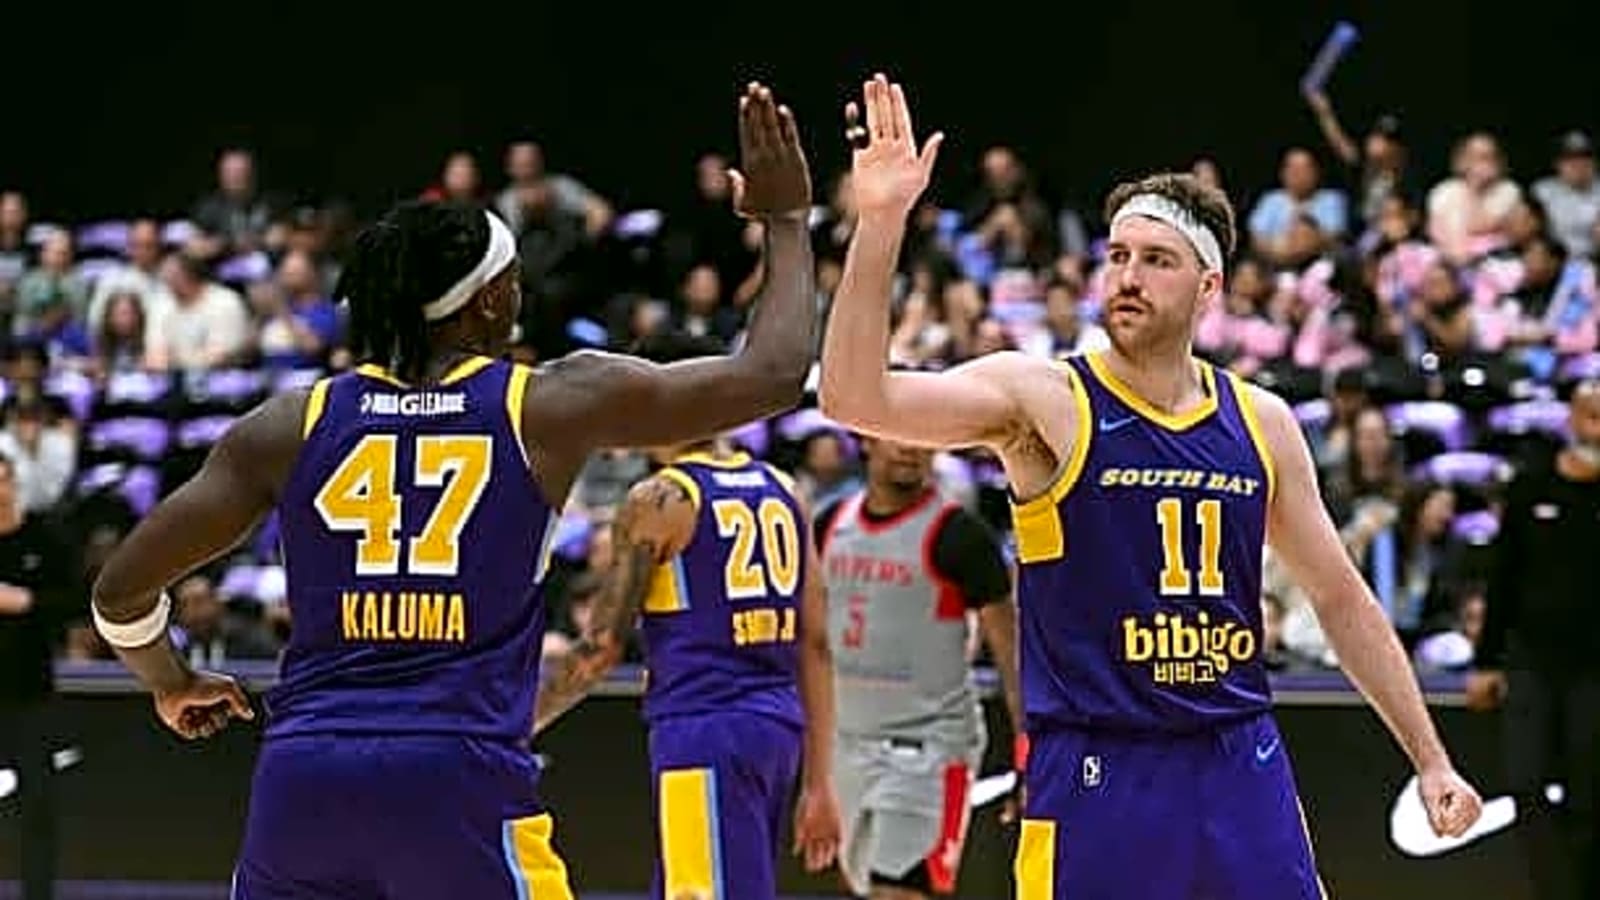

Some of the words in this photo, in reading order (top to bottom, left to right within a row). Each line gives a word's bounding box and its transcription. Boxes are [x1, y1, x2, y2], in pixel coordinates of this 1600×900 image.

[314, 435, 493, 575] 47
[1101, 468, 1204, 487] SOUTH
[1205, 472, 1259, 496] BAY
[712, 498, 800, 599] 20
[1157, 498, 1224, 595] 11
[342, 592, 466, 640] KALUMA
[1123, 611, 1255, 674] bibigo
[1154, 659, 1216, 685] 비비고
